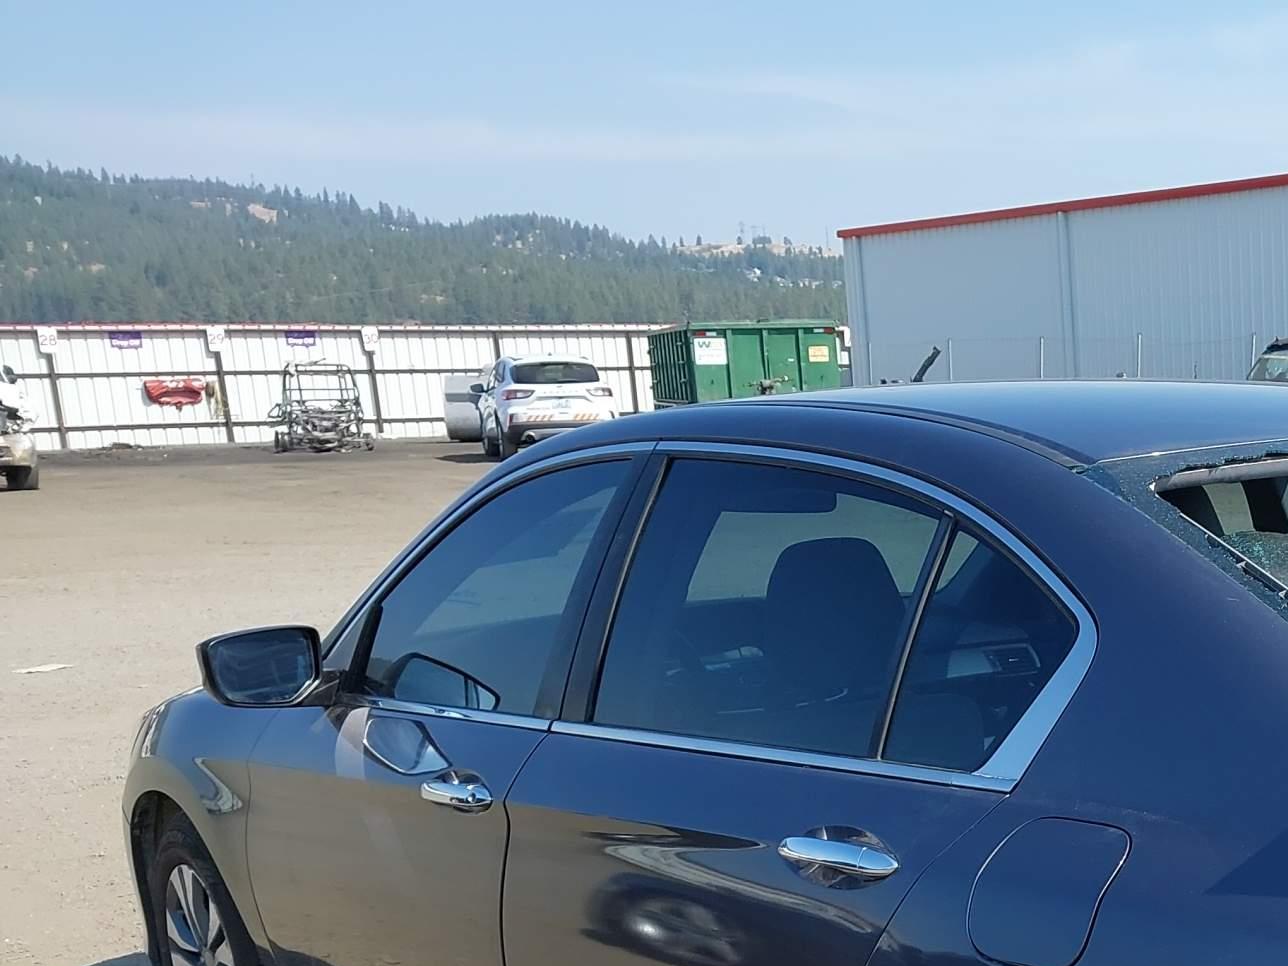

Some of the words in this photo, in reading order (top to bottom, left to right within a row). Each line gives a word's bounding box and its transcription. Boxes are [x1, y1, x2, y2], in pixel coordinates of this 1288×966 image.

[39, 334, 57, 346] 28
[209, 333, 224, 345] 29
[364, 333, 379, 344] 30
